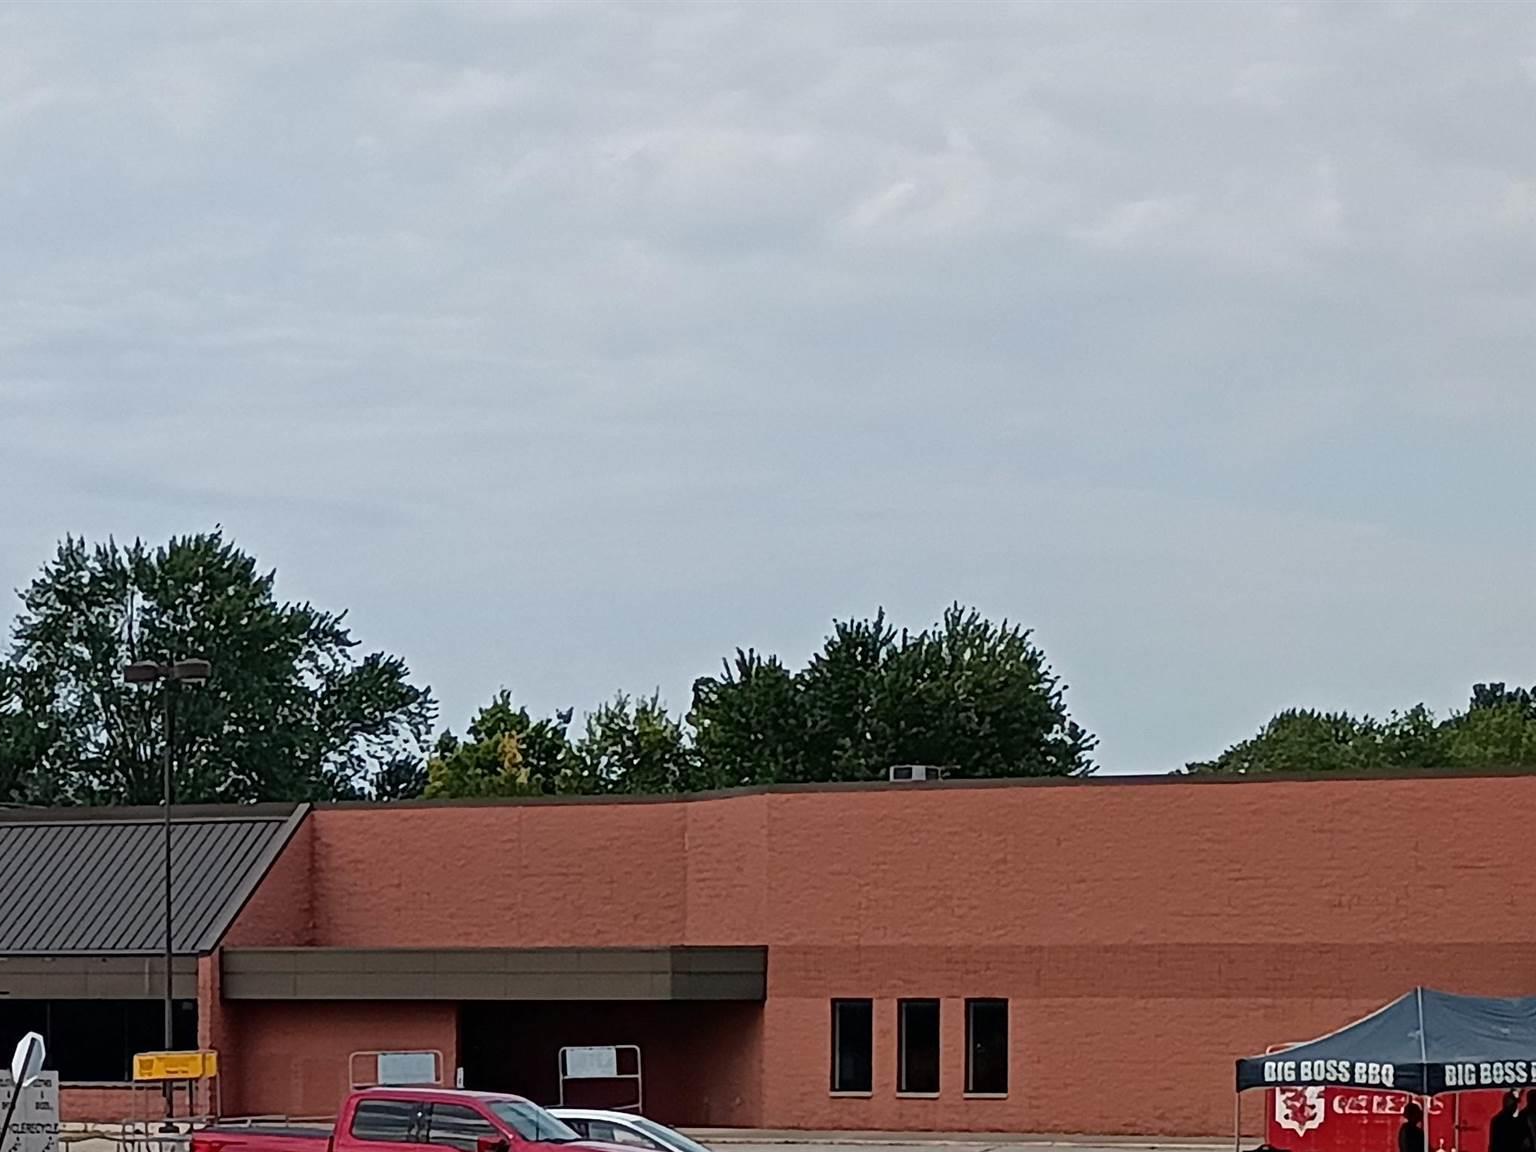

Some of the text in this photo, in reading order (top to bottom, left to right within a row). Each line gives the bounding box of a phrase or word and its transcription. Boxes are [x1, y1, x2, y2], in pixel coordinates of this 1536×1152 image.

[1264, 1060, 1394, 1087] BIG BOSS BBQ
[1445, 1063, 1476, 1086] BIG
[1480, 1061, 1528, 1084] BOSS
